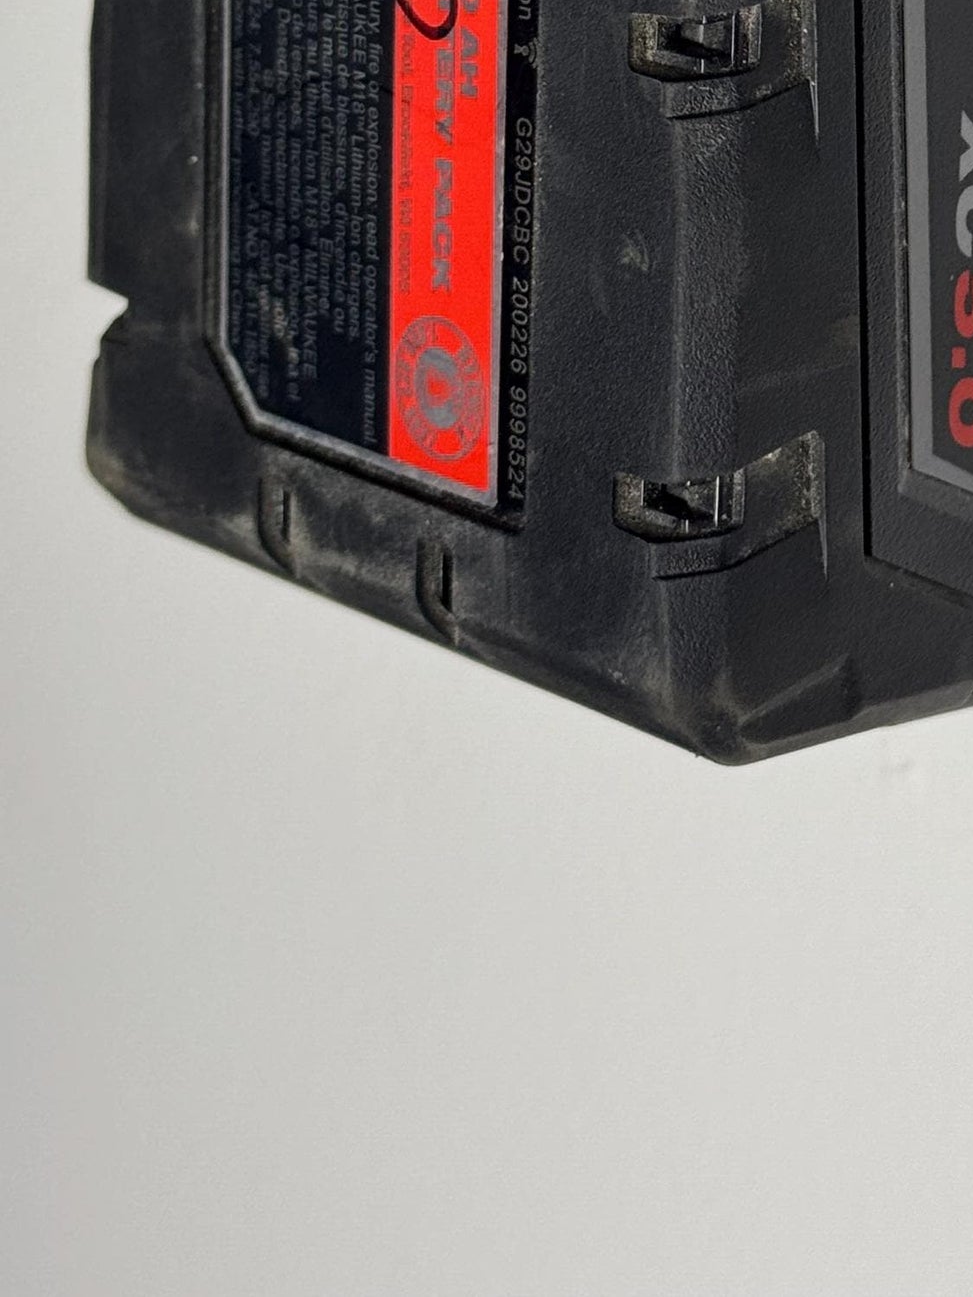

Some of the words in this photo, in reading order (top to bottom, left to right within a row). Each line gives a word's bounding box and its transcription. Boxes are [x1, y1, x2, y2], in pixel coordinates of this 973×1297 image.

[305, 38, 319, 65] au
[322, 12, 336, 31] le
[368, 42, 383, 75] fire
[321, 36, 335, 112] manuel
[336, 63, 351, 90] de
[367, 80, 381, 104] or
[460, 26, 481, 99] AH
[432, 159, 455, 294] PACK
[513, 117, 533, 265] G29JDCBC
[334, 202, 349, 303] d'incendie
[365, 213, 380, 261] read
[302, 248, 318, 381] MILWAUKEE
[333, 307, 346, 334] ou
[363, 264, 379, 364] operator's
[509, 275, 530, 375] 200226
[507, 385, 527, 500] 9998524
